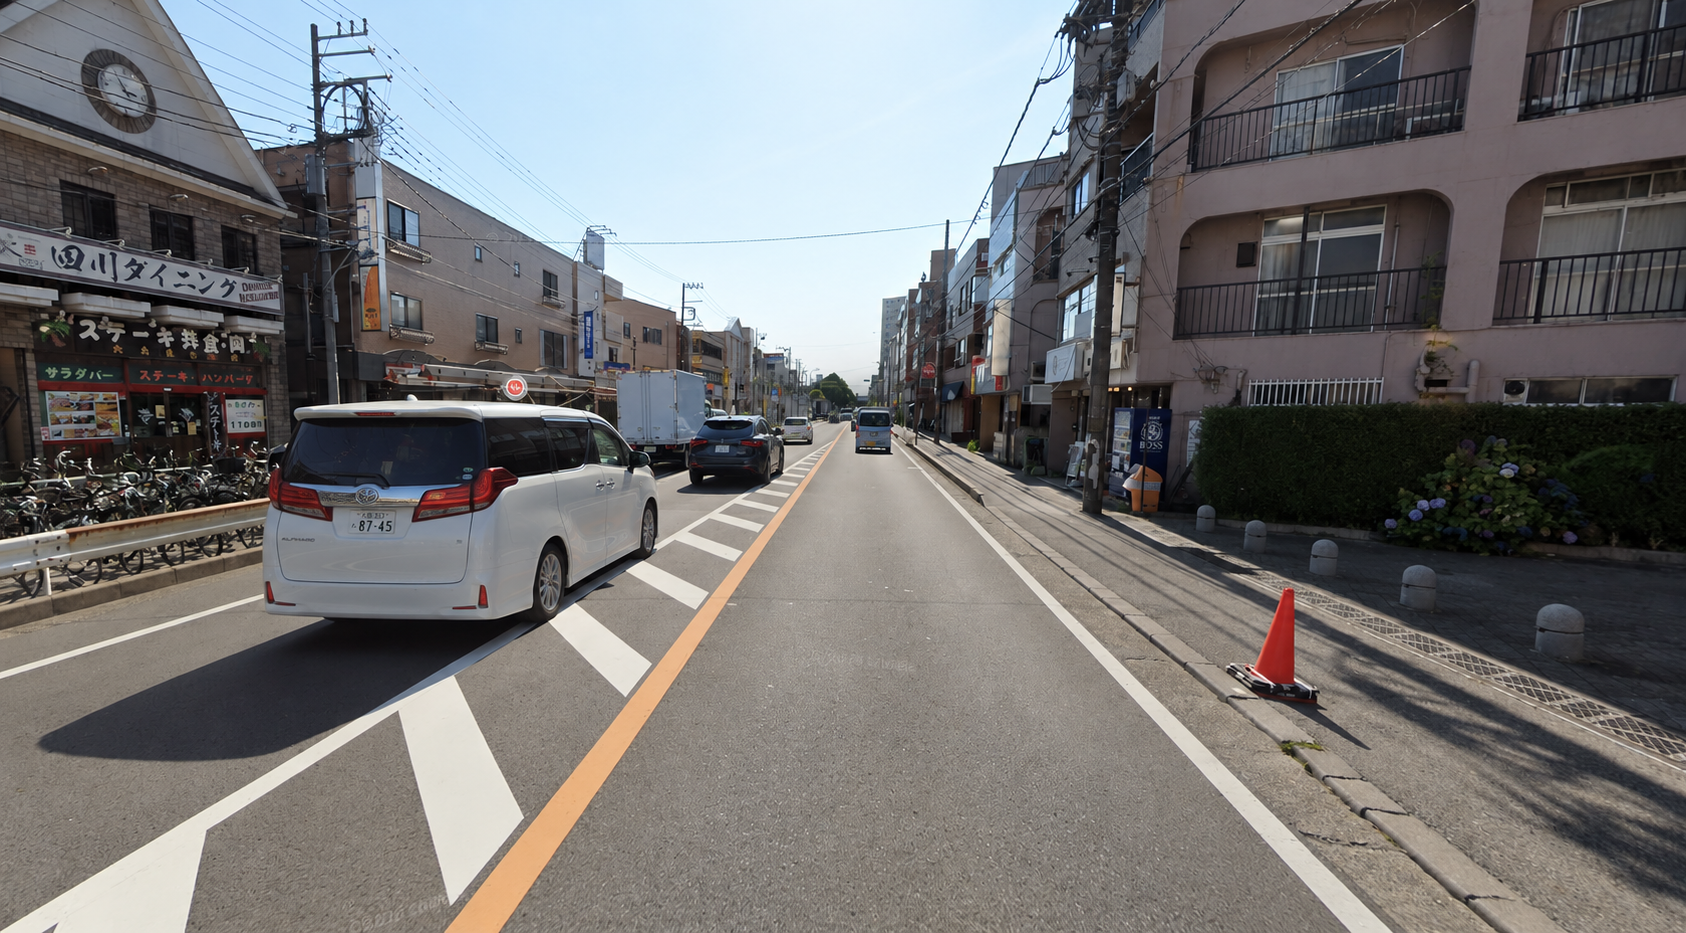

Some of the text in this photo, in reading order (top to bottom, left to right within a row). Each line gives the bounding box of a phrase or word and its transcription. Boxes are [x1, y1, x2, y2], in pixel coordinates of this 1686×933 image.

[45, 367, 113, 379] サラダバー
[1140, 441, 1163, 449] BOSS
[358, 520, 392, 532] 87-45
